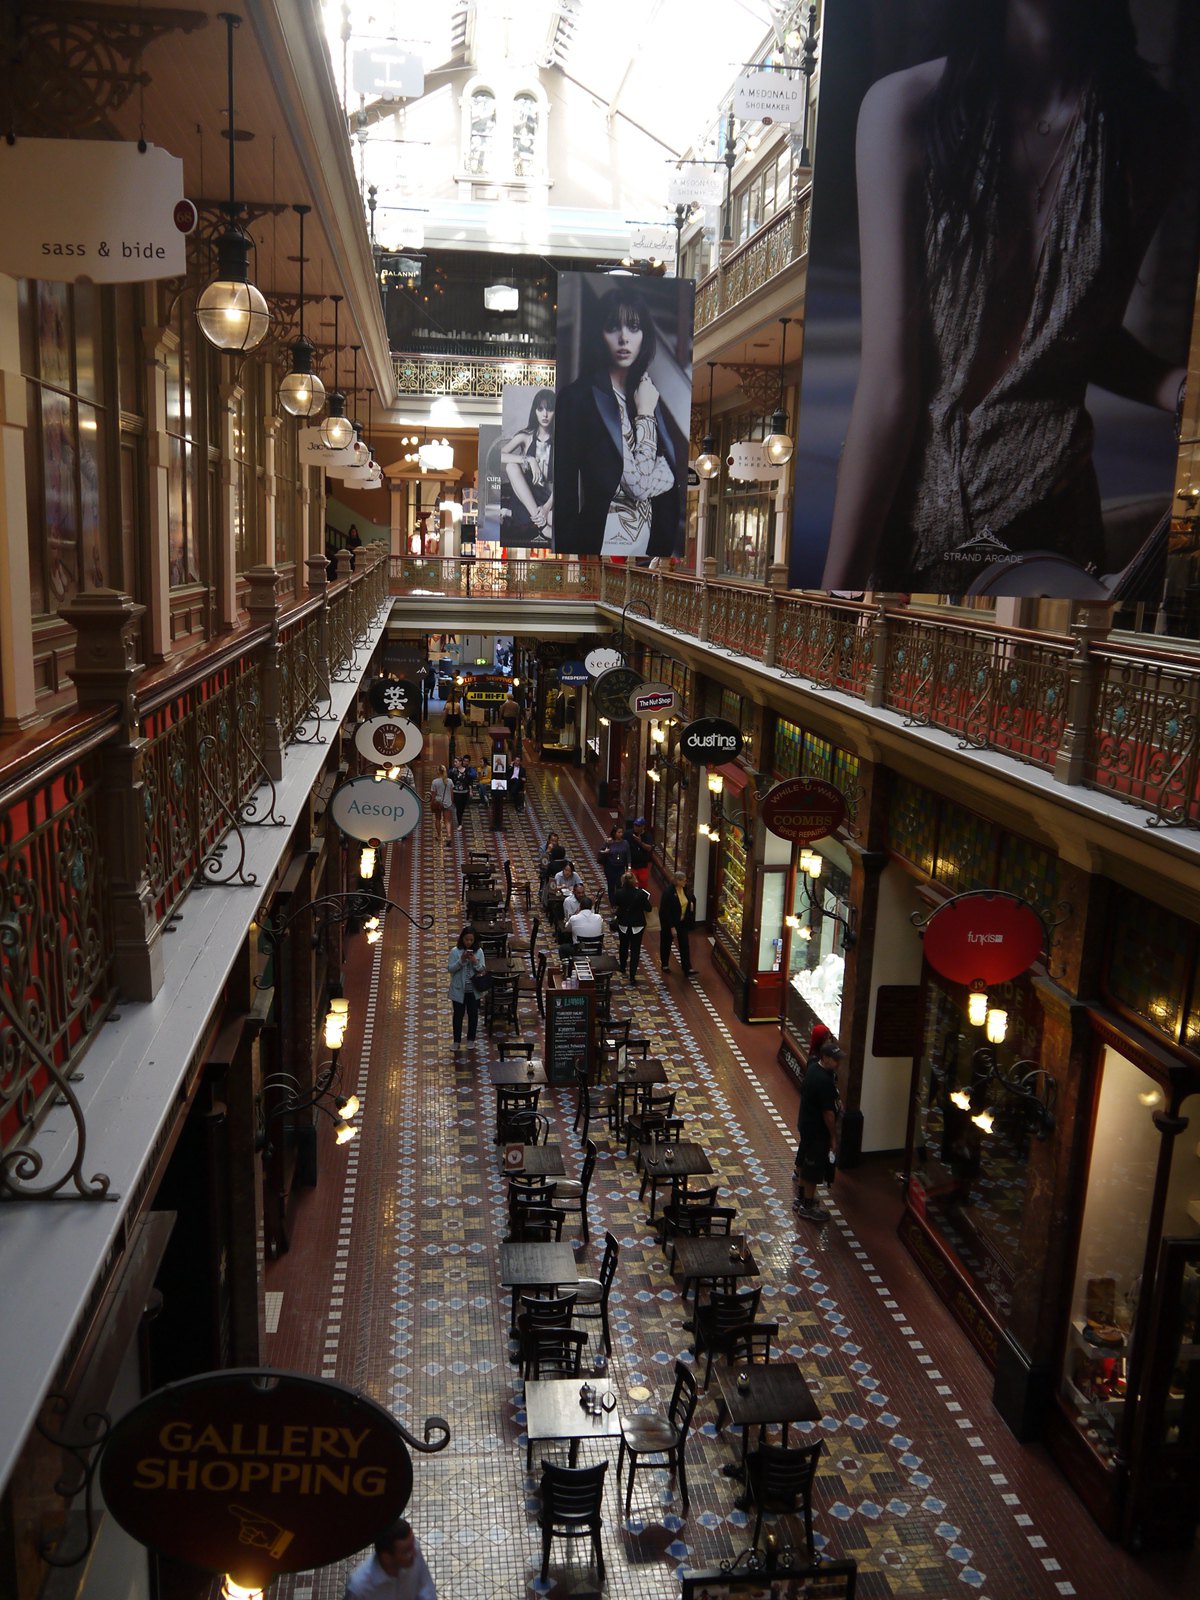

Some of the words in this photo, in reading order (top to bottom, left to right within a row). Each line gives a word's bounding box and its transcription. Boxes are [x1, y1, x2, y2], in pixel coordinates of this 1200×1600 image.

[739, 88, 745, 97] A
[745, 101, 791, 112] SHOEMAKER
[175, 211, 194, 224] 68
[42, 242, 87, 257] sass
[98, 241, 111, 258] &
[122, 242, 166, 260] bide
[943, 551, 981, 562] STRAND
[984, 554, 1024, 564] ARCADE
[639, 700, 649, 708] The
[649, 698, 659, 706] Nut
[658, 697, 672, 705] Shop
[687, 733, 737, 748] dustins
[772, 815, 833, 826] COOMBS
[778, 825, 798, 838] SHOE
[797, 826, 828, 839] REPAIRS
[973, 980, 984, 989] 19
[158, 1421, 372, 1459] GALLERY
[132, 1458, 389, 1497] SHOPPING
